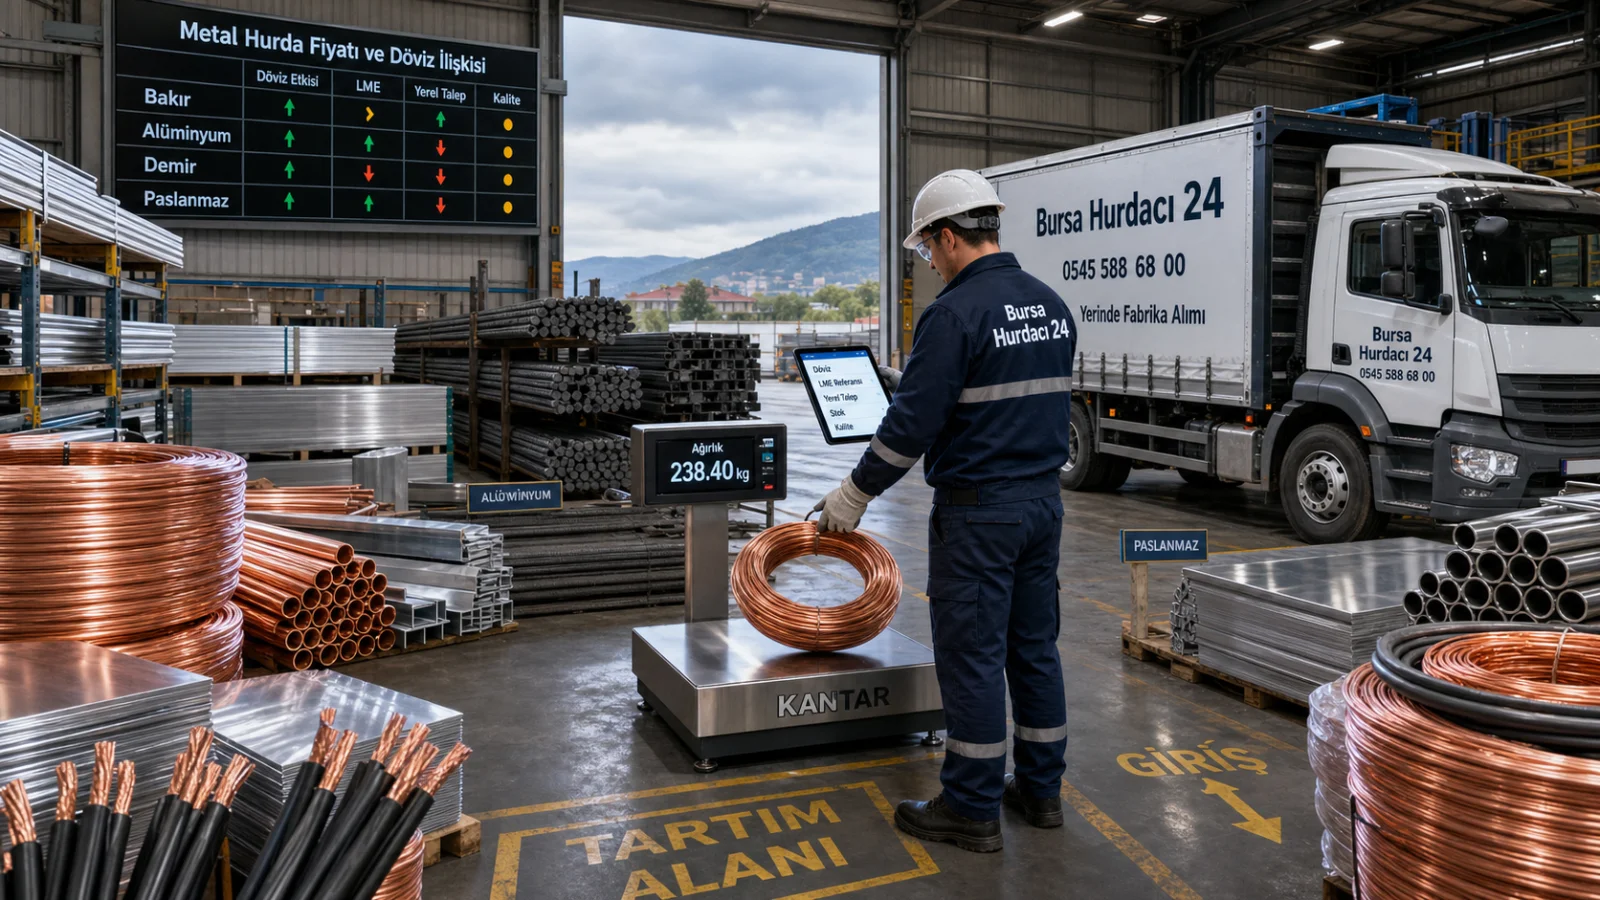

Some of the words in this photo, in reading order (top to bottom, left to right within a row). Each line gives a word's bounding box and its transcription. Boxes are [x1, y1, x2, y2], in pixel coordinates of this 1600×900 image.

[179, 20, 238, 46] Metal
[244, 29, 304, 54] Hurda
[309, 37, 359, 61] Fiyatı
[364, 47, 385, 63] ve
[390, 47, 436, 70] Döviz
[439, 53, 486, 76] İlişkisi
[256, 69, 286, 86] Döviz
[289, 71, 319, 88] Etkisi
[356, 79, 381, 94] LME
[144, 88, 191, 108] Bakır
[414, 85, 439, 100] Yerel
[442, 88, 466, 103] Talep
[493, 92, 521, 106] Kalite
[142, 122, 232, 145] Alüminyum
[144, 156, 197, 175] Demir
[144, 191, 229, 209] Paslanmaz
[1036, 207, 1083, 237] Bursa
[1089, 190, 1174, 231] Hurdacı
[1183, 176, 1225, 221] 24
[1062, 258, 1096, 281] 0545
[1100, 256, 1127, 279] 588
[1135, 254, 1156, 278] 68
[1164, 252, 1186, 277] 00
[1004, 304, 1047, 322] Bursa
[1080, 304, 1121, 323] Yerinde
[1123, 304, 1169, 324] Fabrika
[1171, 304, 1206, 325] Alımı
[992, 323, 1050, 348] Hurdacı
[1050, 318, 1070, 339] 24
[1372, 326, 1412, 343] Bursa
[1359, 345, 1409, 362] Hurdacı
[1413, 346, 1433, 363] 24
[818, 379, 833, 388] LME
[1359, 368, 1382, 380] 0545
[1385, 369, 1404, 381] 588
[1406, 369, 1419, 382] 68
[1422, 370, 1436, 383] 00
[829, 408, 846, 417] Stok
[691, 443, 724, 456] Ağırlık
[670, 459, 734, 483] 238.40
[736, 466, 750, 483] kg
[1134, 539, 1200, 552] PASLANMAZ
[777, 686, 891, 718] KANTAR
[565, 799, 842, 866] TARTIM
[620, 836, 849, 900] ALANI
